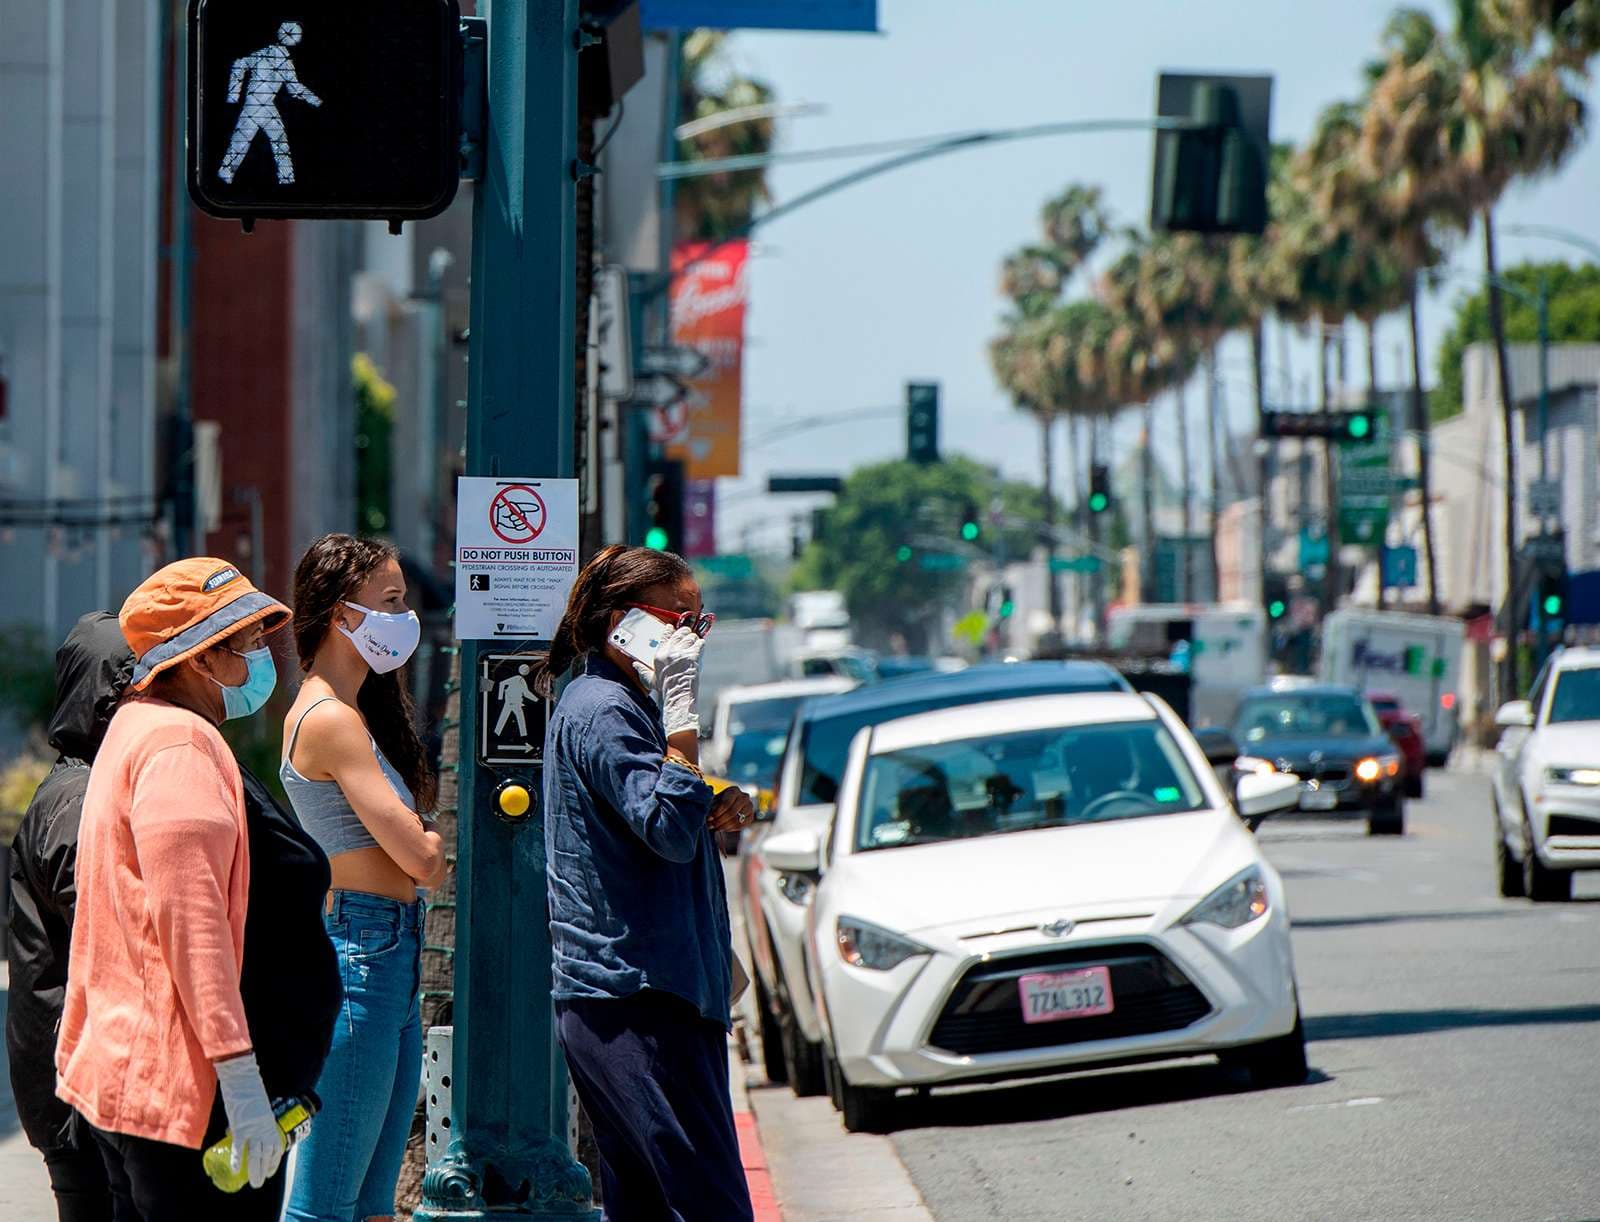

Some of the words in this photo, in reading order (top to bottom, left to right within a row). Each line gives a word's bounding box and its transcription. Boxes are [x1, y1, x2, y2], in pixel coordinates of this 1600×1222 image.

[463, 551, 478, 559] DO
[481, 551, 502, 560] NOT
[504, 551, 530, 560] PUSH
[533, 552, 572, 561] BUTTON
